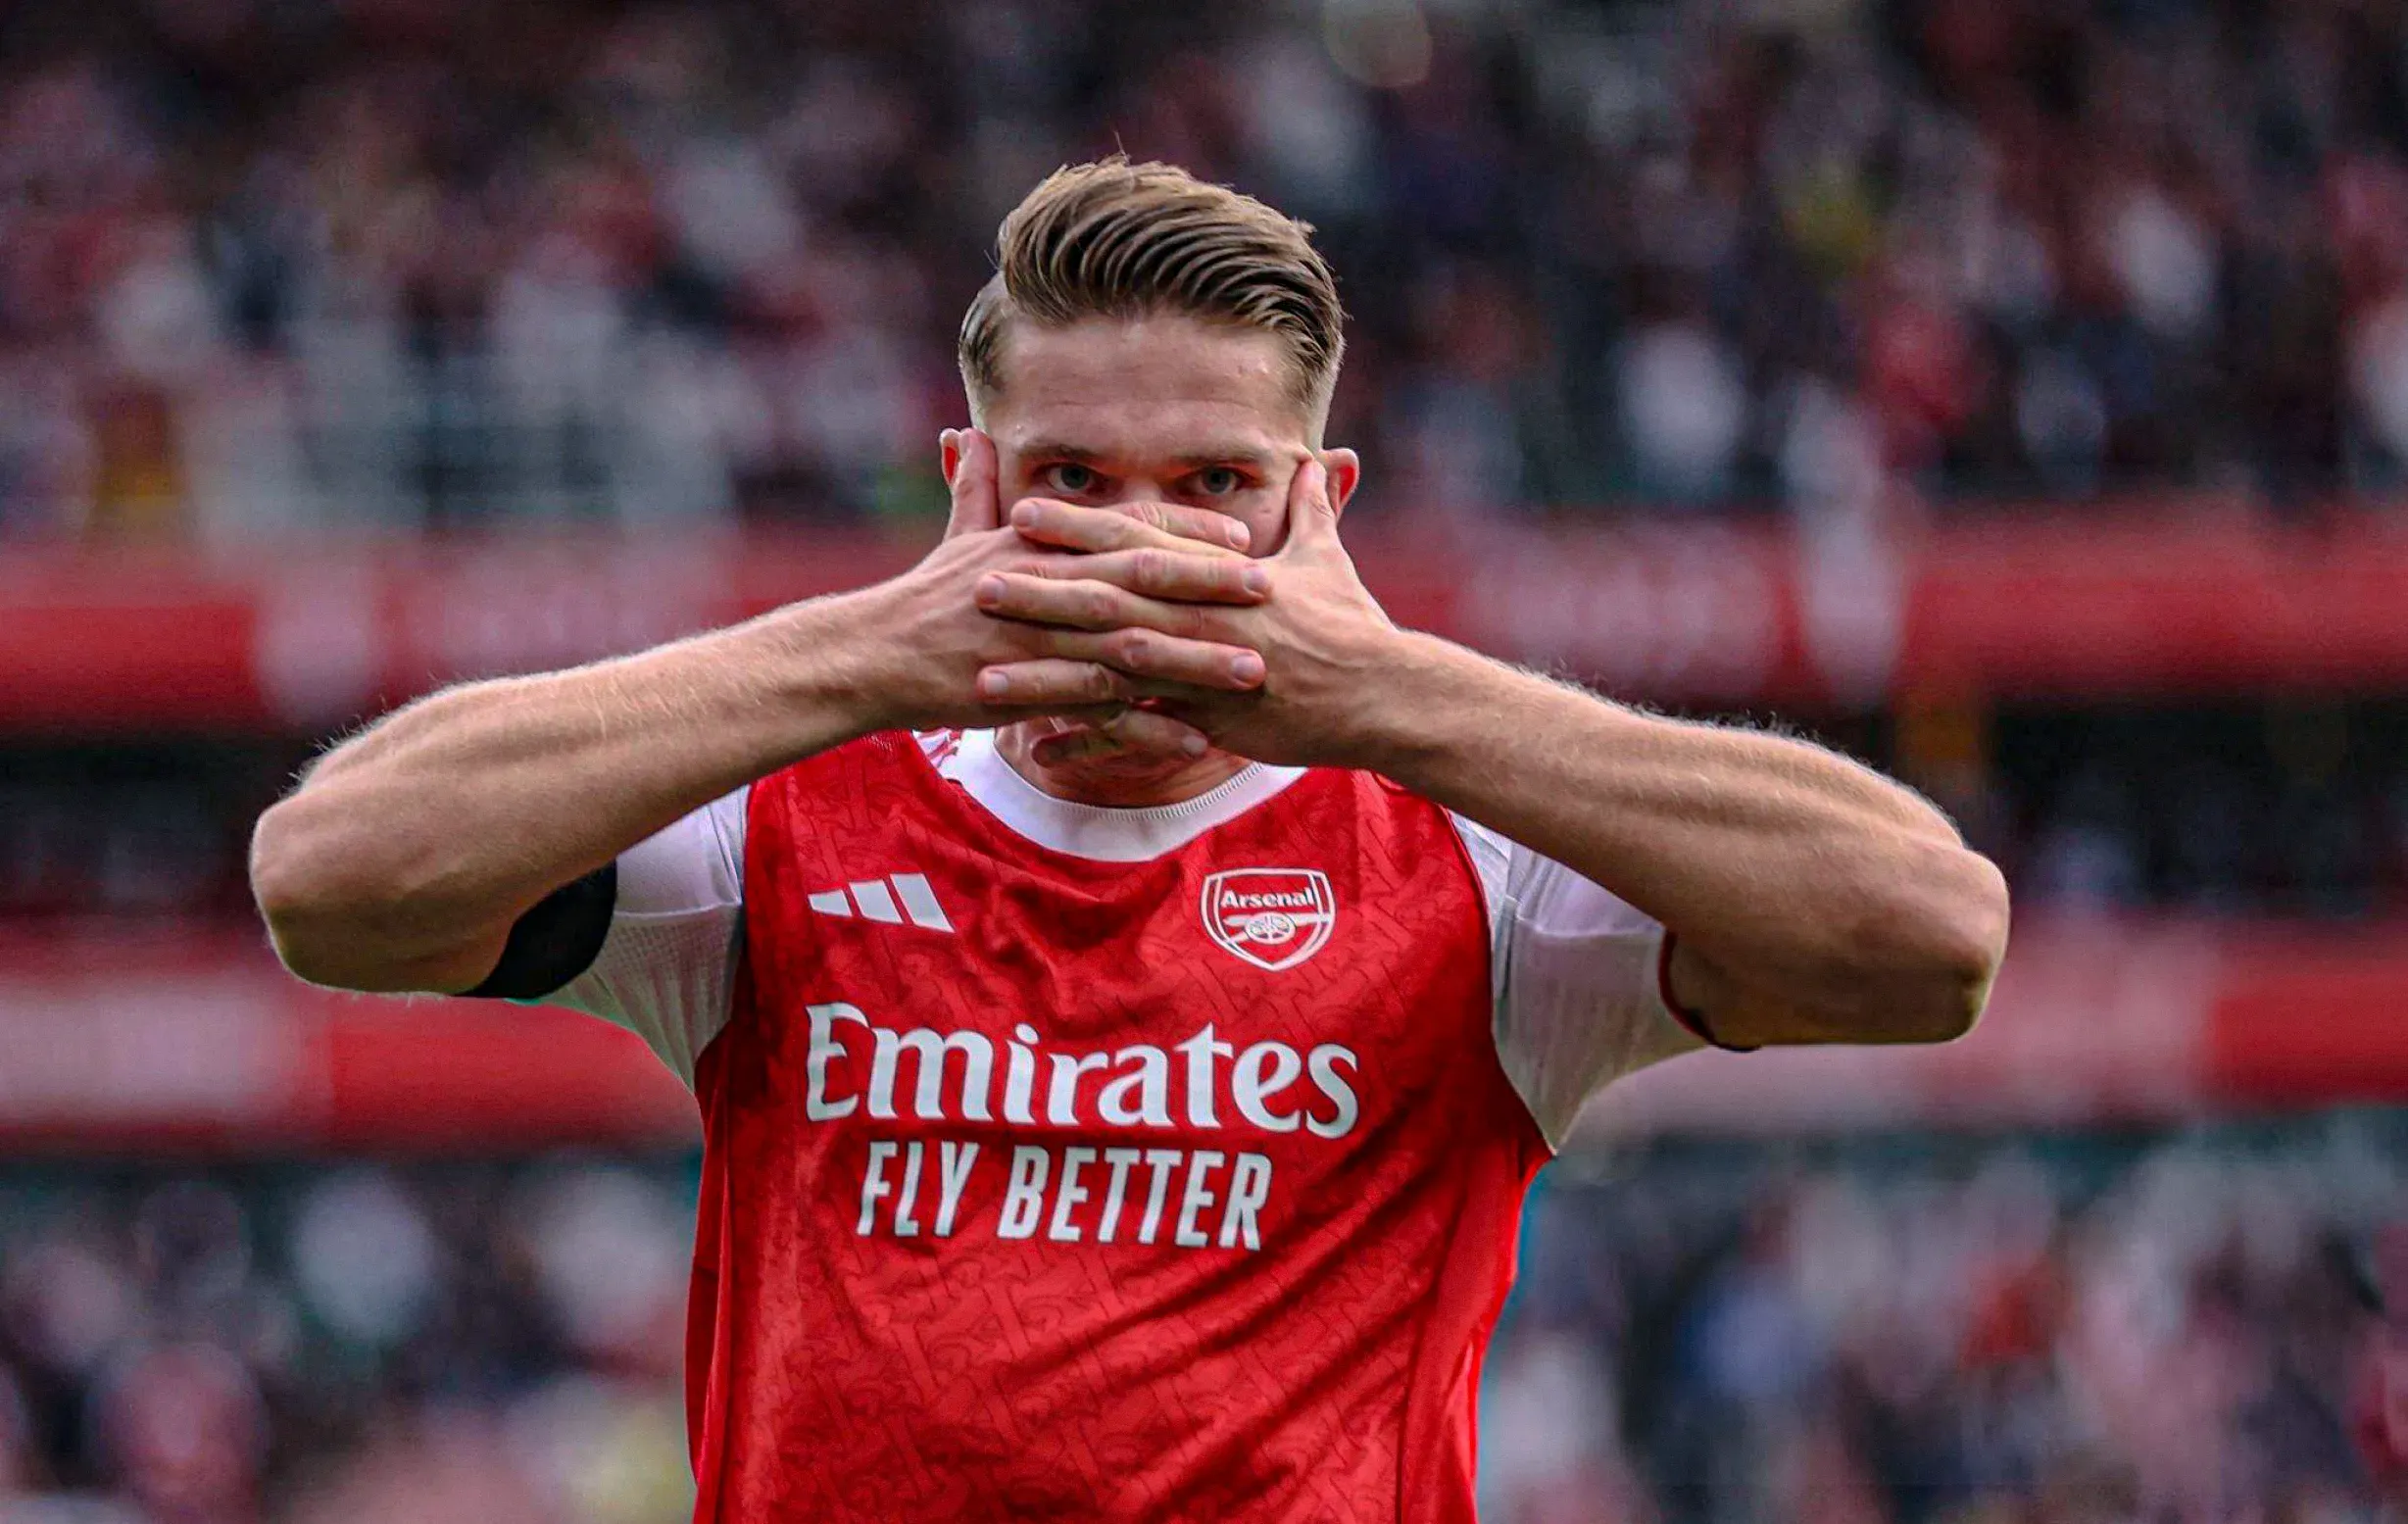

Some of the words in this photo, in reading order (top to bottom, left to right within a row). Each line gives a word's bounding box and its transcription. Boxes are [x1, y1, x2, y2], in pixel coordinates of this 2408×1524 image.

[1220, 887, 1315, 909] Arsenal
[806, 1002, 1358, 1139] Emirates
[856, 1141, 979, 1238] FLY
[997, 1146, 1272, 1251] BETTER
